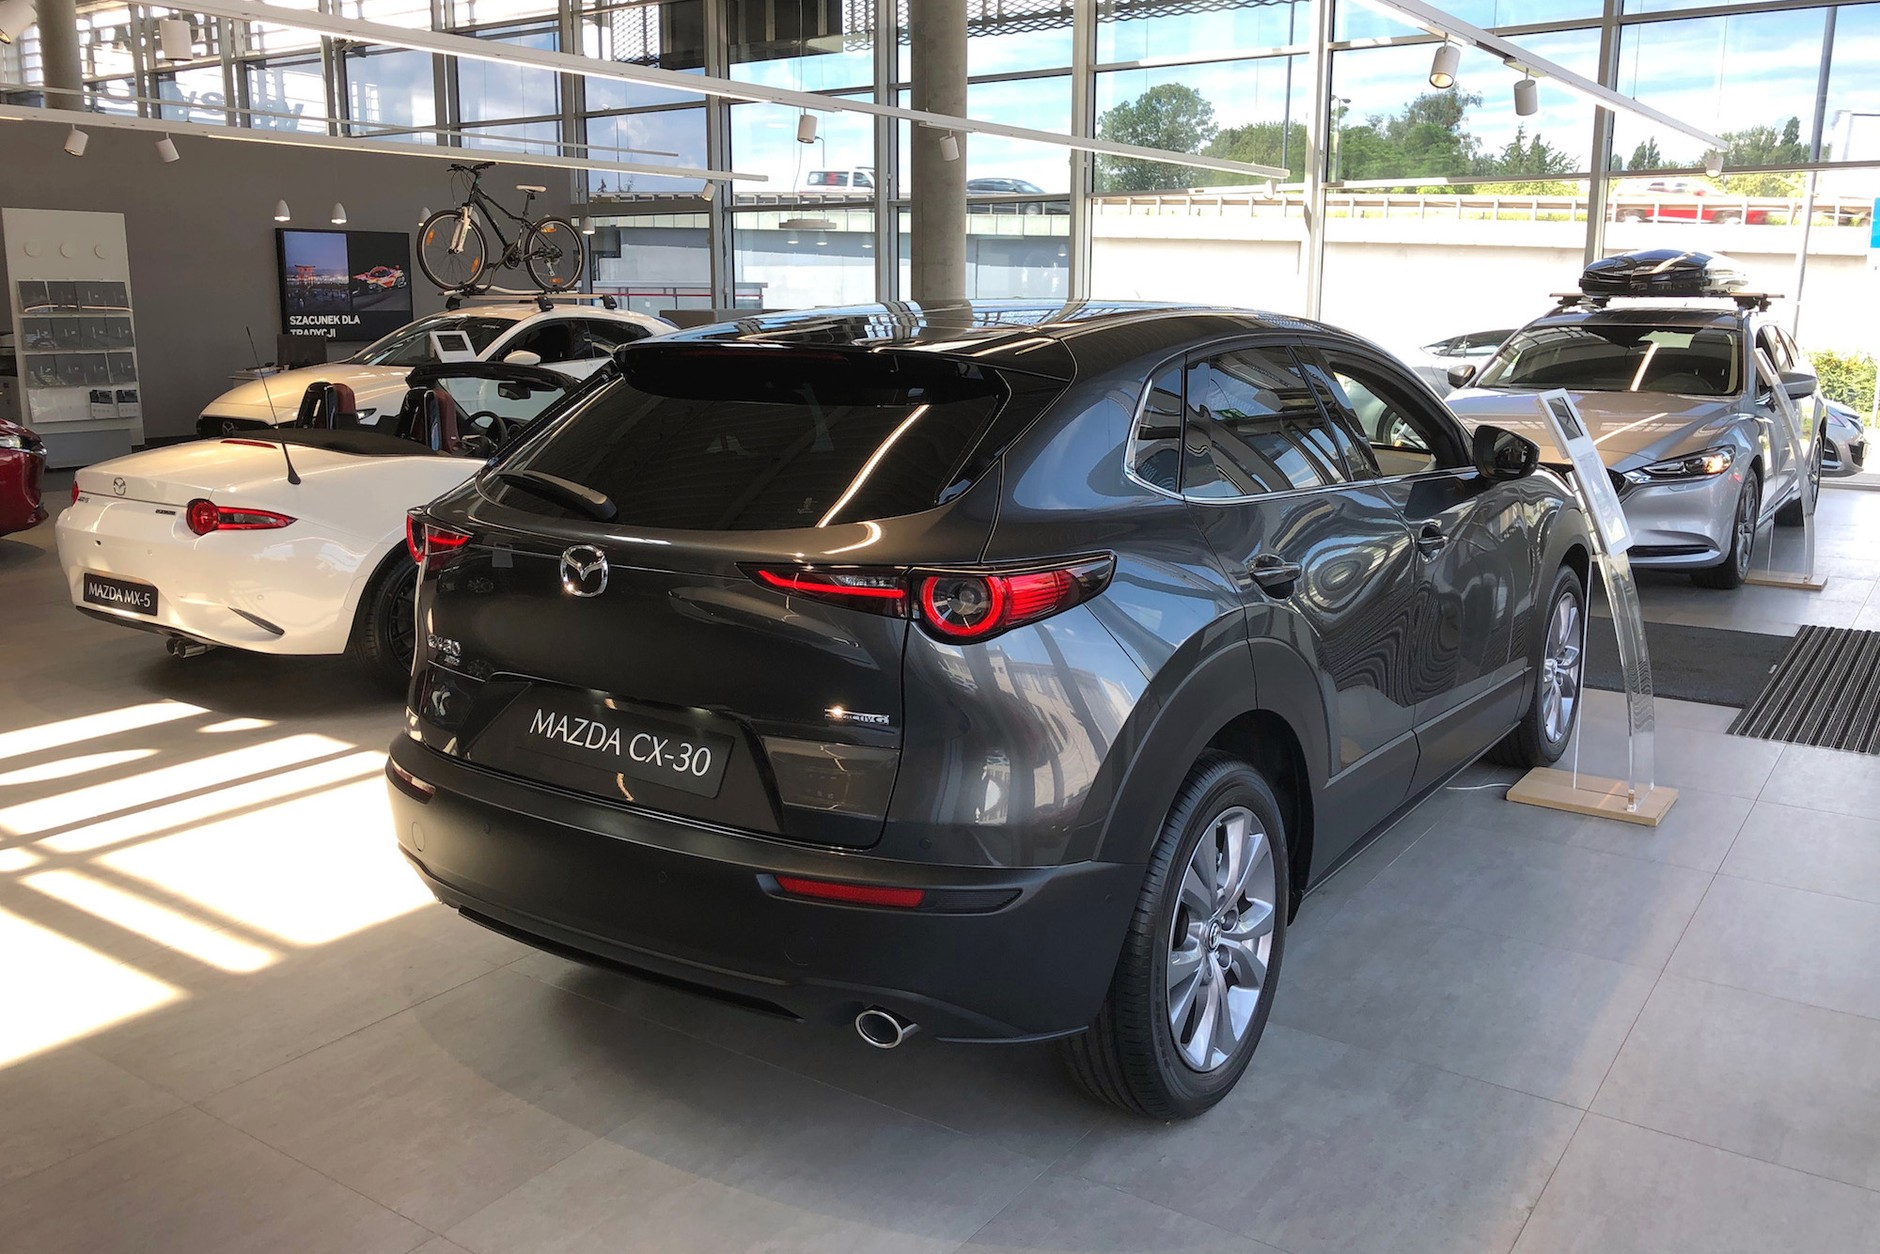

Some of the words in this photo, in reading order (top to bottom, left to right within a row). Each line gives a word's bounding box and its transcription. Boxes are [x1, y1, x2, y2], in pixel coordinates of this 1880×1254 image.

[289, 314, 341, 326] SZACUNEK
[341, 314, 361, 325] DLA
[289, 328, 337, 338] TRADYCJI
[88, 582, 123, 603] MAZDA
[124, 589, 151, 608] MX-5
[529, 708, 621, 756] MAZDA
[629, 732, 712, 777] CX-30
